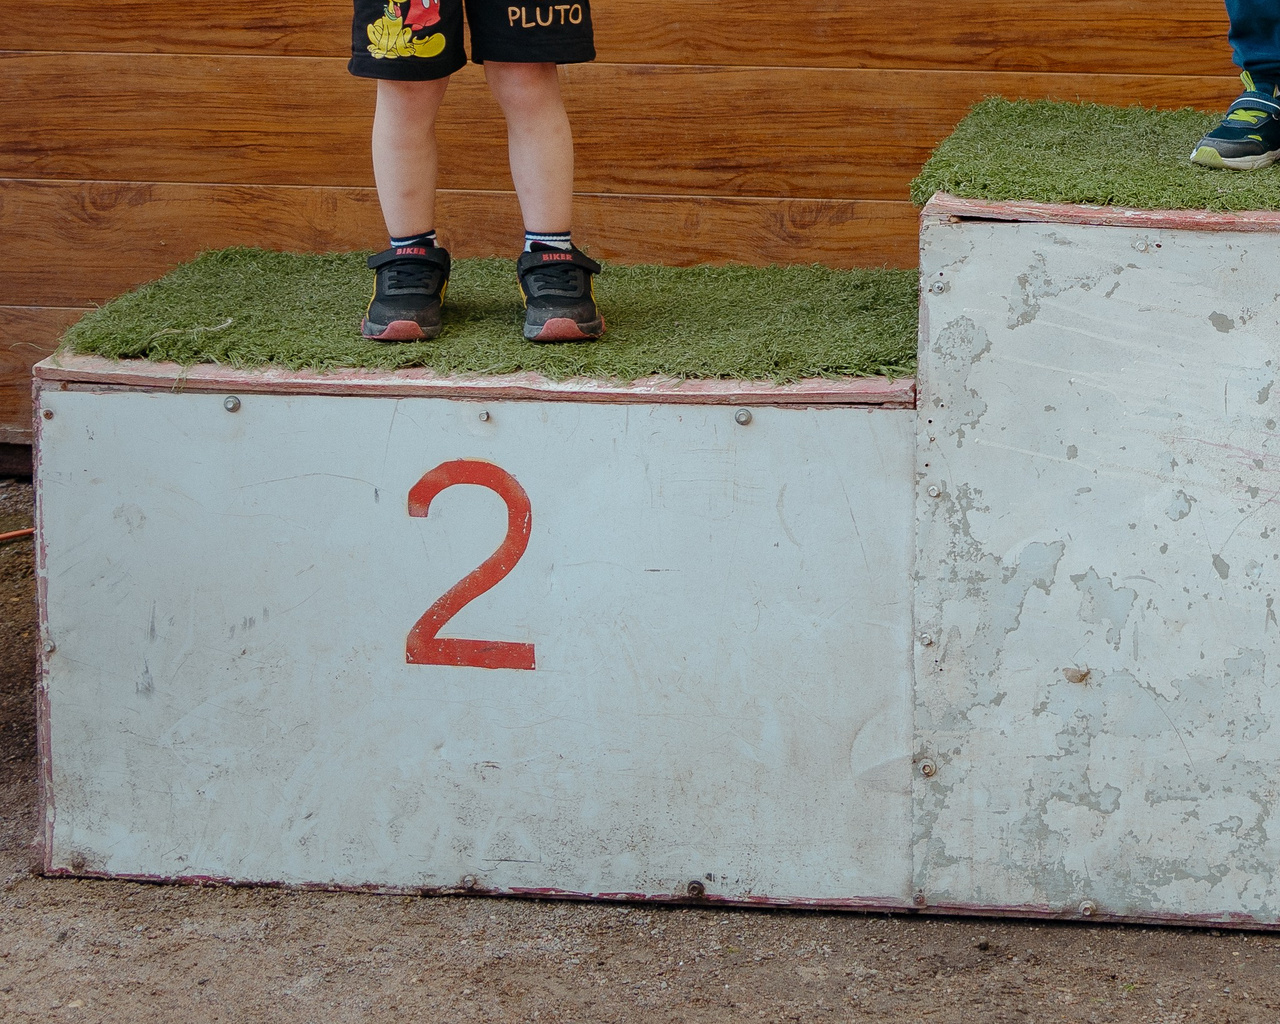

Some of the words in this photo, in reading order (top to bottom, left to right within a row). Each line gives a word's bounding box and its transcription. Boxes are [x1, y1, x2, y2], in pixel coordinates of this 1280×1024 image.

[507, 3, 583, 29] PLUTO
[395, 247, 426, 256] BIKER
[542, 253, 573, 262] BIKER
[406, 458, 536, 670] 2
